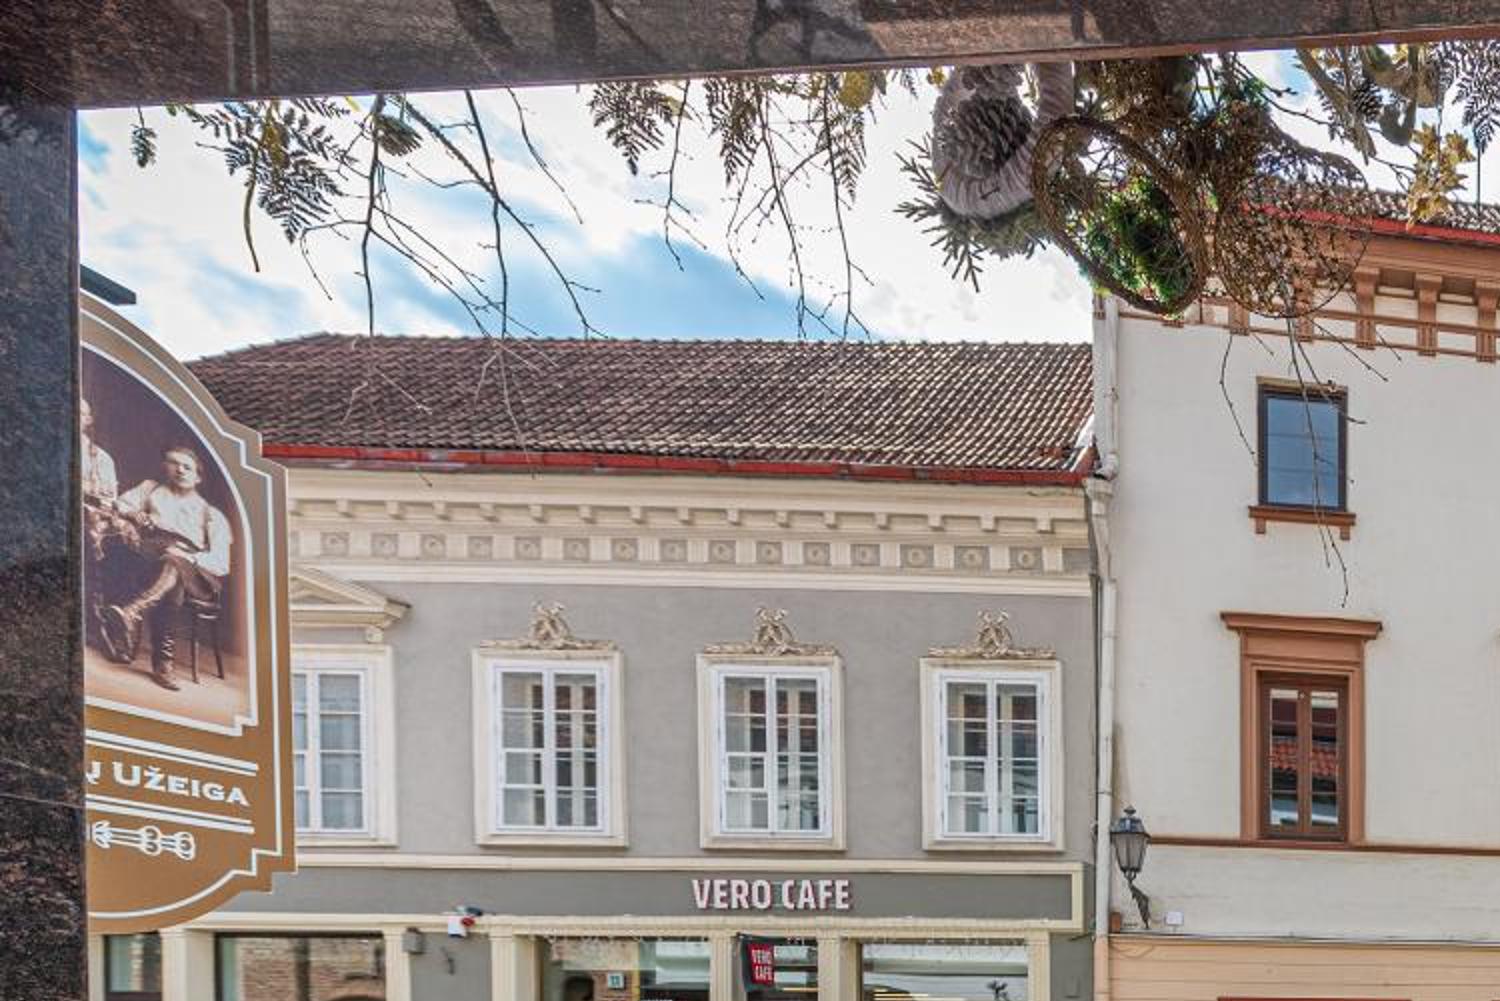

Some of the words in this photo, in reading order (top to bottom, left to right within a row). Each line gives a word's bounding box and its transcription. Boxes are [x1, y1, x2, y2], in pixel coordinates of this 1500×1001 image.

[112, 761, 250, 807] UŽEIGA
[692, 879, 771, 909] VERO
[781, 879, 849, 909] CAFE
[751, 949, 772, 964] VERO
